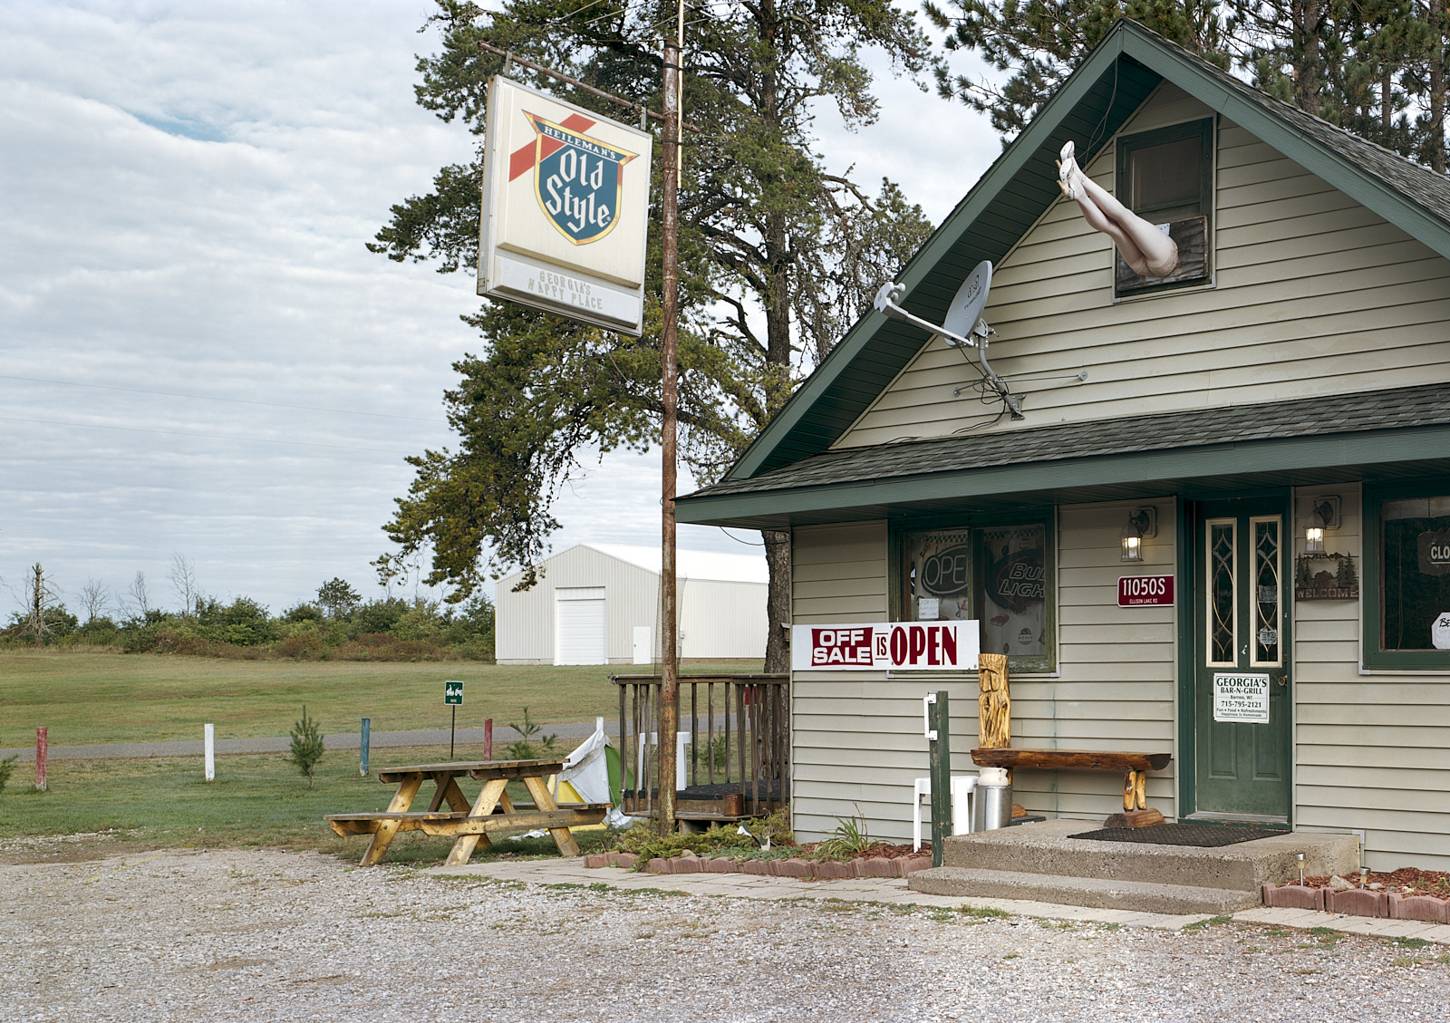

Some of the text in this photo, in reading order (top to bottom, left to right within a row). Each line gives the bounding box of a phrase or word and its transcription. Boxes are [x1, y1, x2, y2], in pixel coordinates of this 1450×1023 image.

[544, 125, 616, 160] HEILEMAN'S
[559, 148, 604, 191] Old
[545, 174, 611, 233] Style
[571, 292, 603, 310] PLACE
[925, 555, 967, 586] OPE
[999, 579, 1045, 598] LIGH
[1123, 578, 1166, 596] 11050S
[1297, 588, 1359, 598] WELCOME
[819, 630, 864, 646] OFF
[876, 625, 957, 666] IS OPEN
[813, 647, 871, 663] SALE
[1216, 677, 1267, 688] GEORGIA'S
